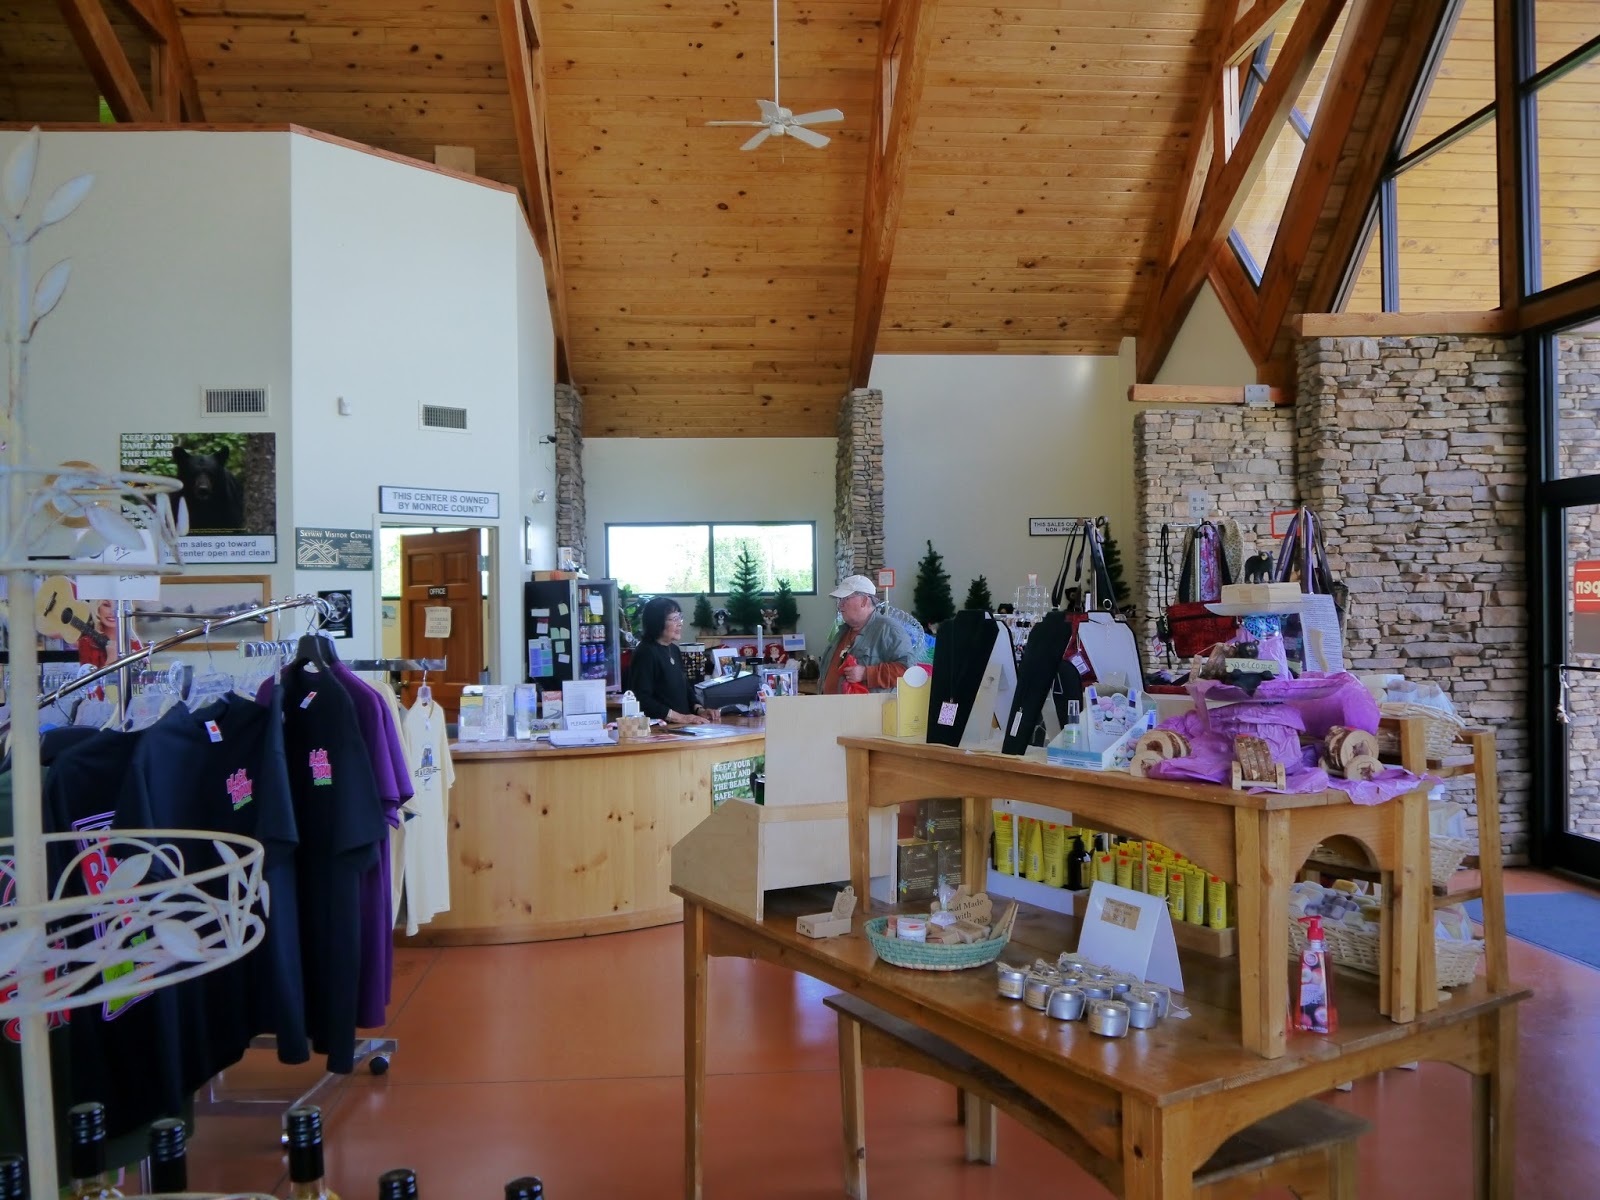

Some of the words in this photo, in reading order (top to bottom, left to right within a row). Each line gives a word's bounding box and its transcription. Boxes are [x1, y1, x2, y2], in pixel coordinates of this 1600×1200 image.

[121, 434, 146, 442] KEEP
[121, 442, 153, 450] FAMILY
[121, 450, 140, 458] THE
[142, 450, 173, 458] BEARS
[121, 458, 148, 466] SAFE!
[393, 492, 412, 500] THIS
[414, 493, 448, 502] CENTER
[450, 495, 458, 503] IS
[459, 496, 490, 504] OWNED
[398, 502, 410, 510] BY
[412, 502, 449, 511] MONROE
[451, 504, 484, 513] COUNTY
[324, 530, 348, 538] VISITOR
[349, 531, 372, 539] CENTER
[191, 540, 213, 548] sales
[215, 541, 226, 549] go
[228, 540, 257, 548] toward
[208, 550, 228, 558] open
[248, 548, 271, 556] clean
[429, 587, 446, 596] OFFICE
[713, 763, 732, 772] KEEP
[734, 759, 751, 768] YOUR
[713, 771, 737, 782] FAMILY
[738, 768, 751, 778] AND
[713, 782, 728, 791] THE
[729, 778, 750, 789] BEARS
[714, 790, 734, 801] SAFE!
[963, 898, 984, 910] Made
[954, 911, 972, 921] with
